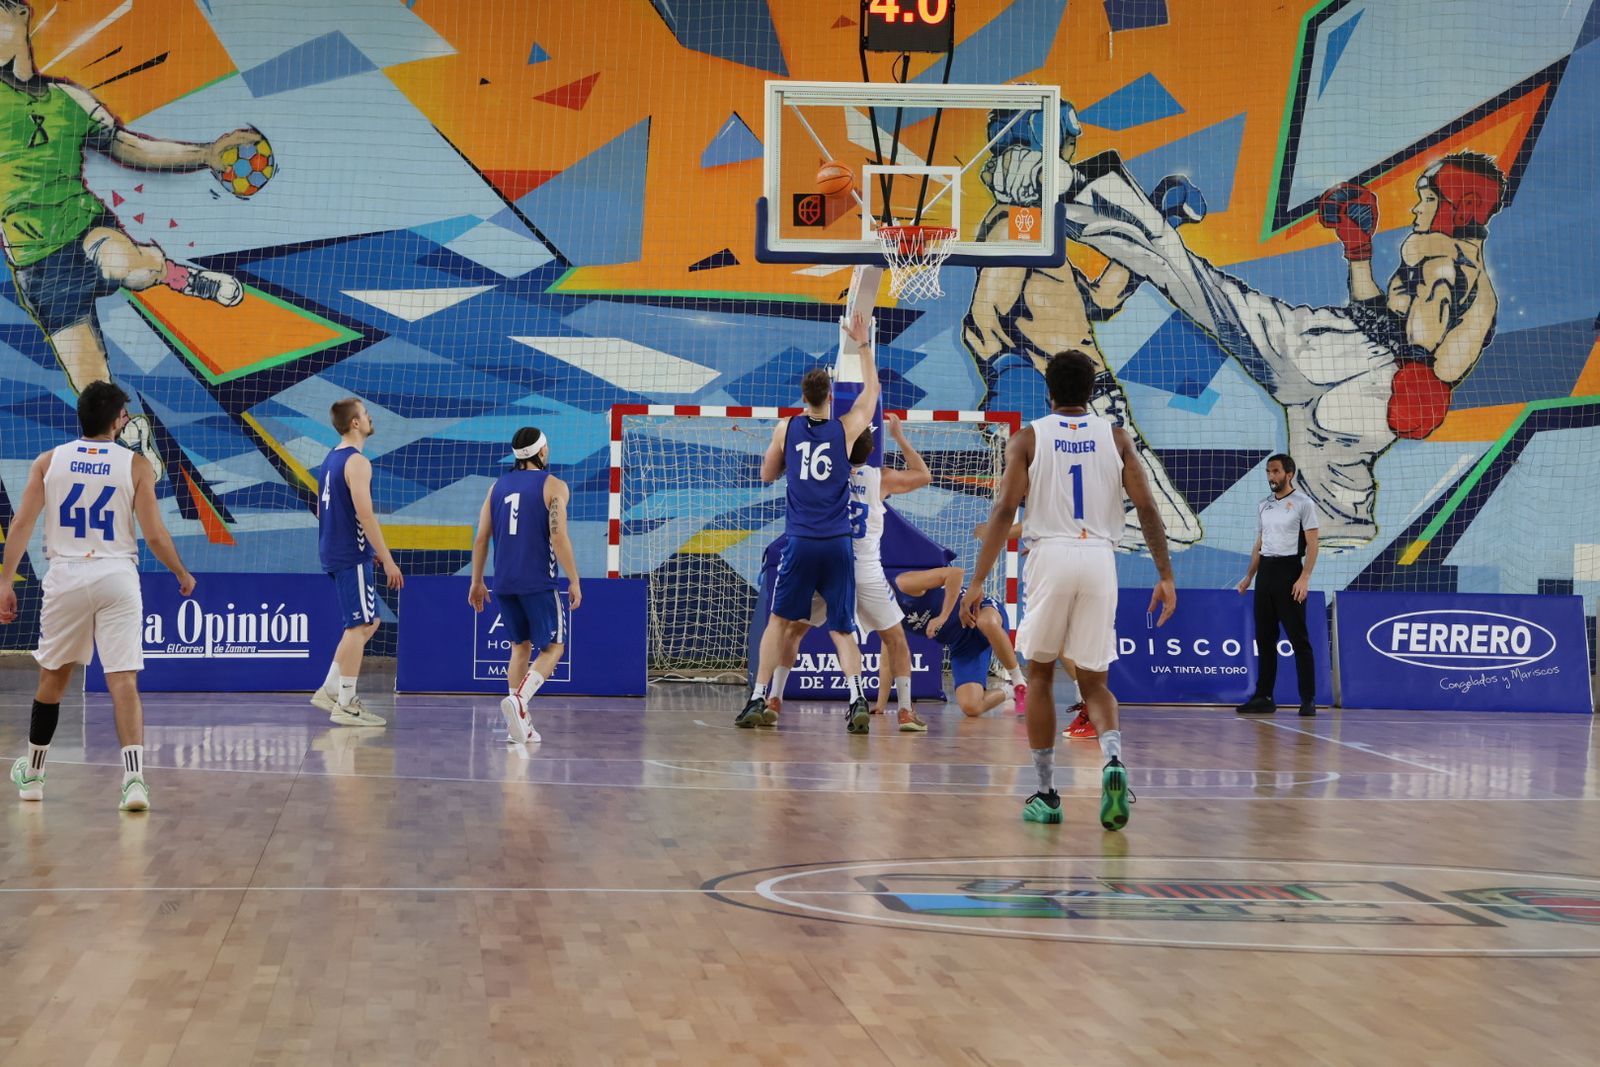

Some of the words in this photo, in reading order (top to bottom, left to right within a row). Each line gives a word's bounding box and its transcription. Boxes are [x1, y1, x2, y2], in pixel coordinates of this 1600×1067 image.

[869, 0, 948, 24] 4.0
[1054, 439, 1096, 454] POIRIER
[70, 460, 111, 475] GARCÍA
[795, 441, 833, 481] 16
[1068, 464, 1084, 520] 1
[60, 483, 116, 541] 44
[504, 492, 520, 535] 1
[177, 599, 310, 657] Opinión
[1391, 622, 1532, 655] FERRERO
[166, 643, 175, 653] El
[175, 643, 204, 653] Correo
[213, 643, 224, 653] de
[224, 643, 256, 653] Zamora
[800, 676, 824, 689] DE
[830, 676, 897, 689] ZAMO
[1151, 666, 1171, 674] UVA
[1173, 666, 1201, 674] TINTA
[1204, 666, 1217, 675] DE
[1219, 666, 1248, 675] TORO
[1440, 673, 1498, 693] Congelados
[1501, 675, 1511, 689] y
[1510, 666, 1560, 682] Mariscos
